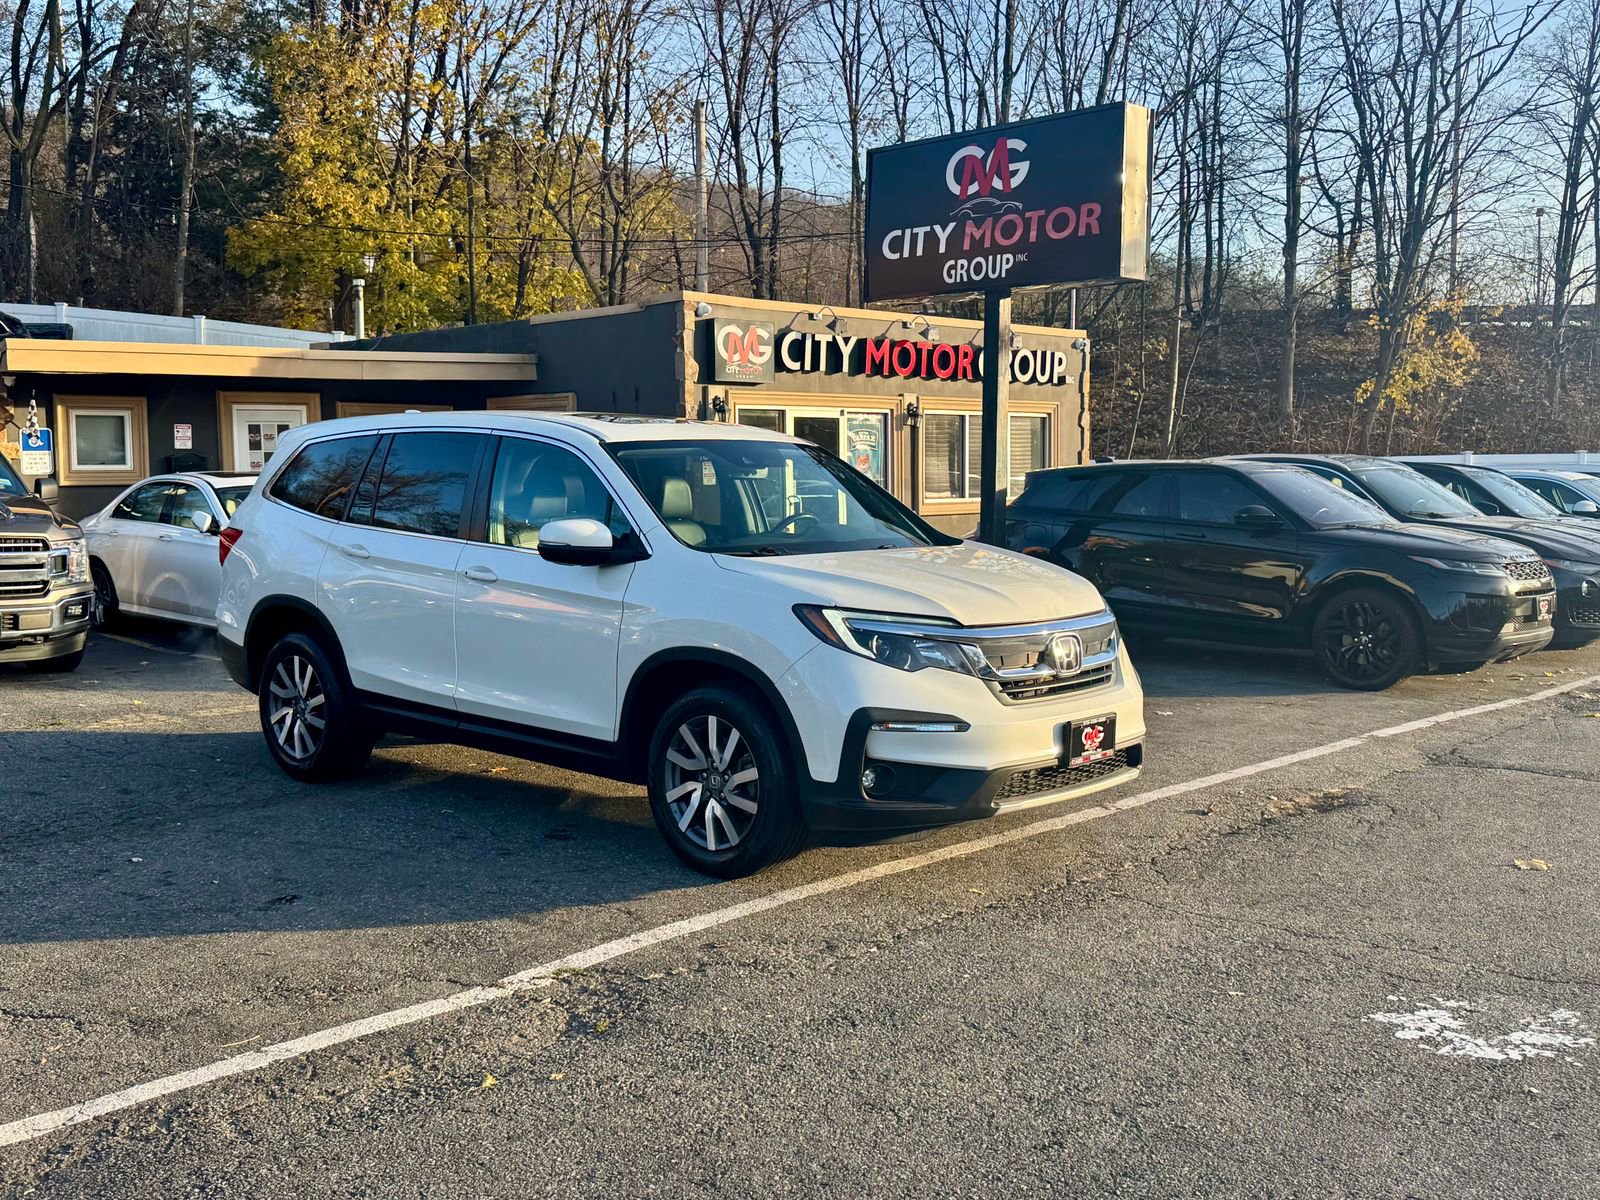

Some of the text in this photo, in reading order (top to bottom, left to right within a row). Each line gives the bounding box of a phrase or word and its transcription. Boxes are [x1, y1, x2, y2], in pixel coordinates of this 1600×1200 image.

[882, 202, 1101, 260] CITY MOTOR
[942, 252, 1028, 284] GROUP INC
[780, 331, 858, 373] CITY
[865, 339, 973, 379] MOTOR
[978, 348, 1067, 384] OUP
